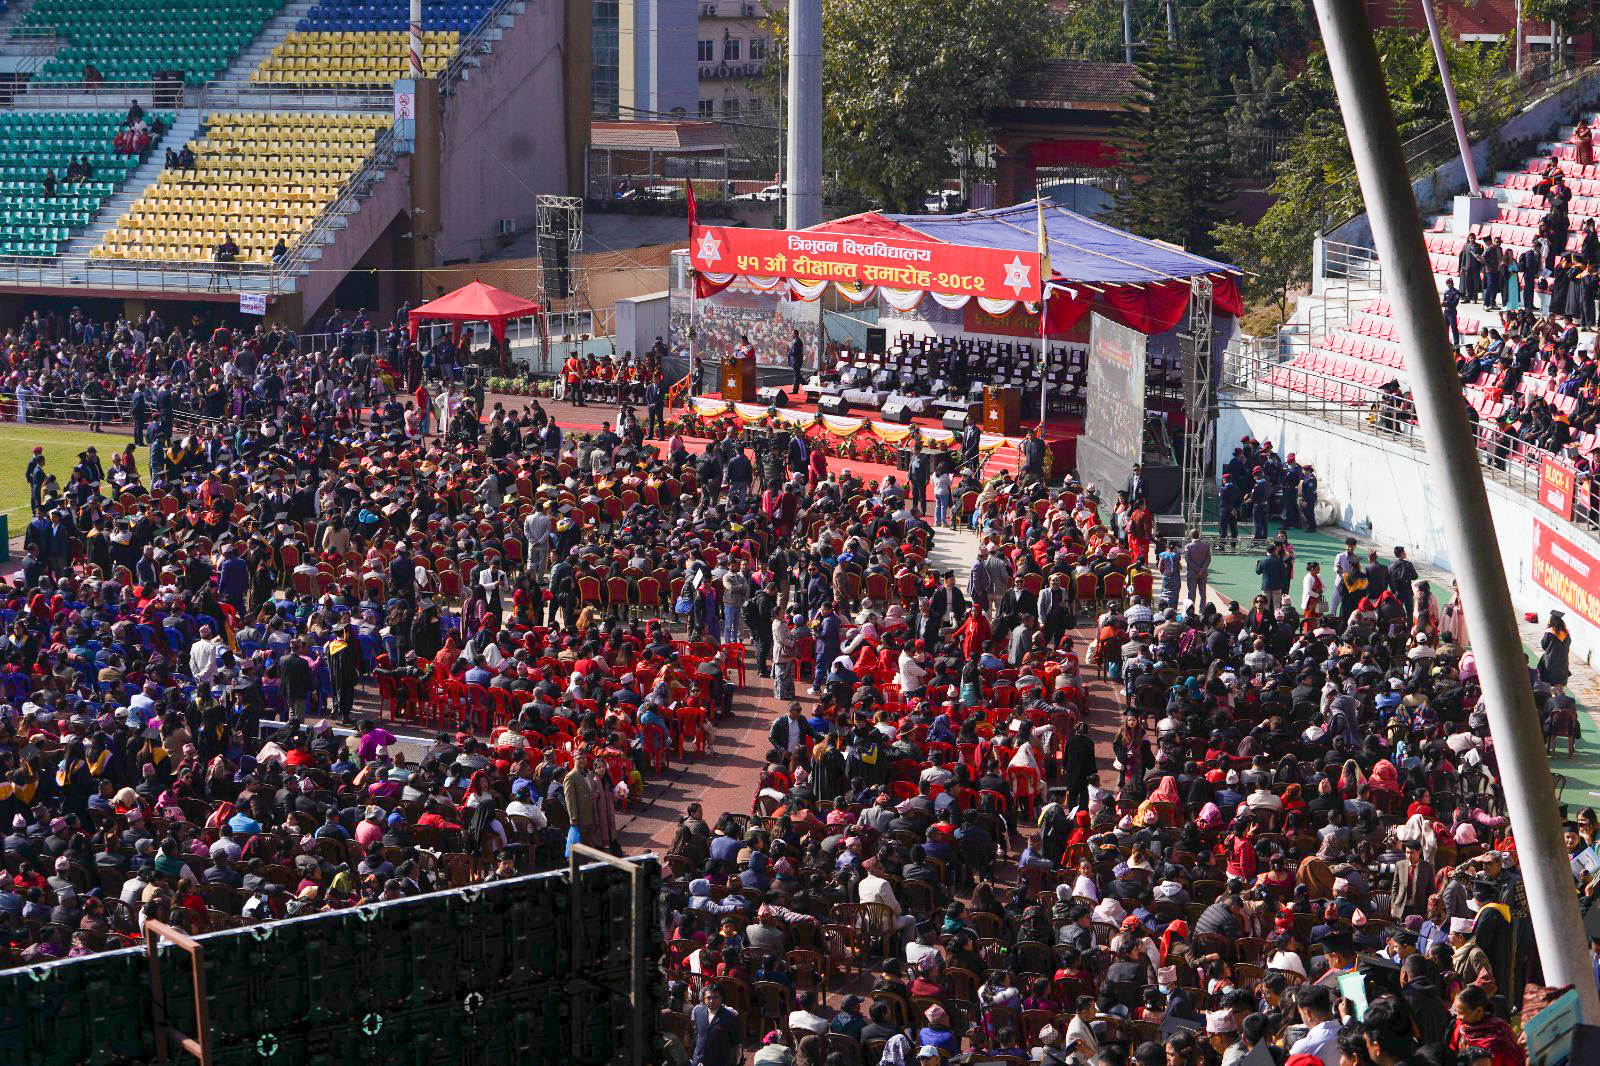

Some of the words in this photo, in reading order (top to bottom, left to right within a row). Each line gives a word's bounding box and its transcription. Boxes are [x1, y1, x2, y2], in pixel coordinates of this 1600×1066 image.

[787, 235, 838, 255] त्रिभुवन
[842, 238, 931, 262] विश्वविद्यालय
[737, 255, 759, 271] ५१
[792, 255, 858, 278] दीक्षान्त
